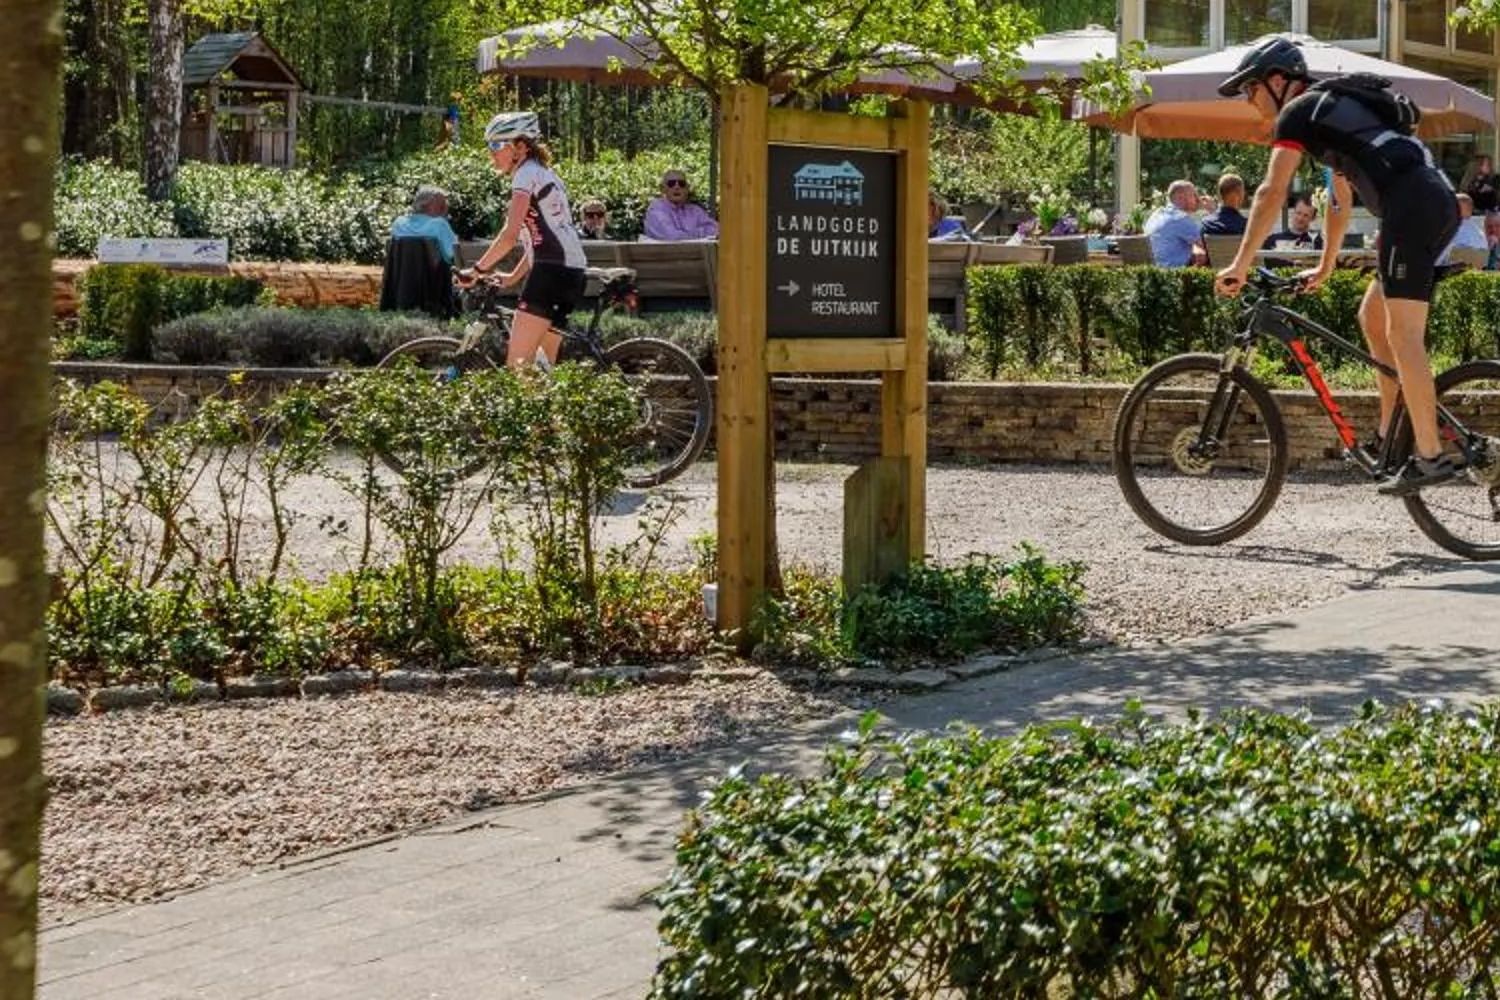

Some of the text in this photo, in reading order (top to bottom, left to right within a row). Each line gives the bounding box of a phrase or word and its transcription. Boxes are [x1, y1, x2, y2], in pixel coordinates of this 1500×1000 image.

[777, 215, 879, 234] LANDGOED
[777, 237, 879, 257] DE UITKIJK
[812, 282, 848, 297] HOTEL
[812, 301, 880, 316] RESTAURANT
